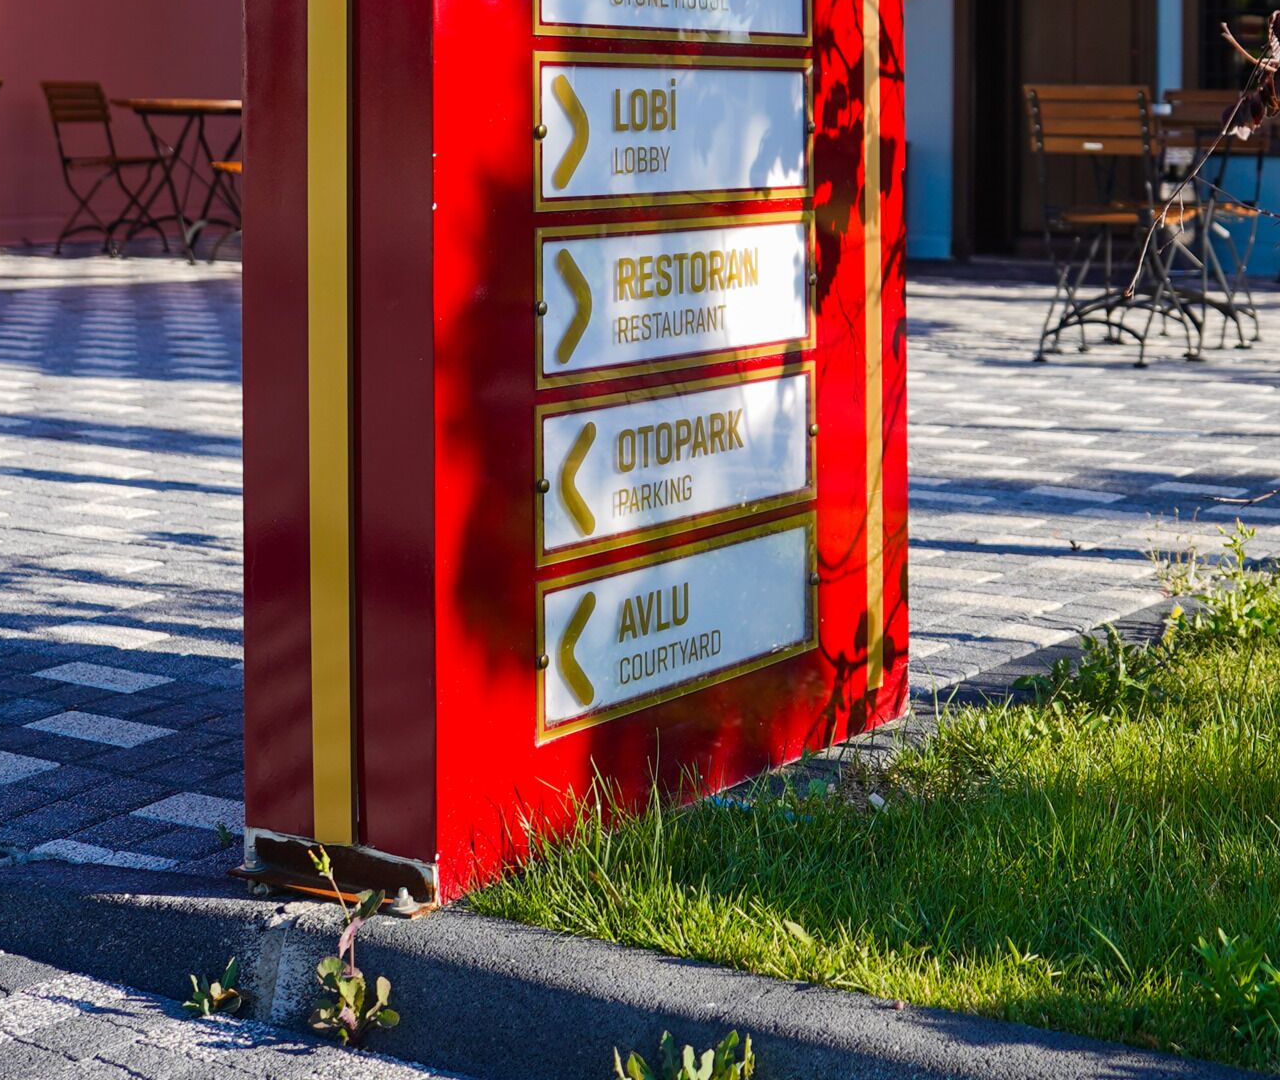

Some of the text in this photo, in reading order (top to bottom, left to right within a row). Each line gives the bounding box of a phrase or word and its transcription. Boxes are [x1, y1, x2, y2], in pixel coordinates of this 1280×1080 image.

[614, 78, 677, 132] LOBİ
[614, 146, 670, 175] LOBBY
[618, 247, 759, 301] RESTORAN
[618, 305, 727, 344] RESTAURANT
[618, 408, 744, 473] OTOPARK
[619, 474, 693, 516] PARKING
[618, 582, 689, 643] AVLU
[619, 629, 721, 685] COURTYARD
